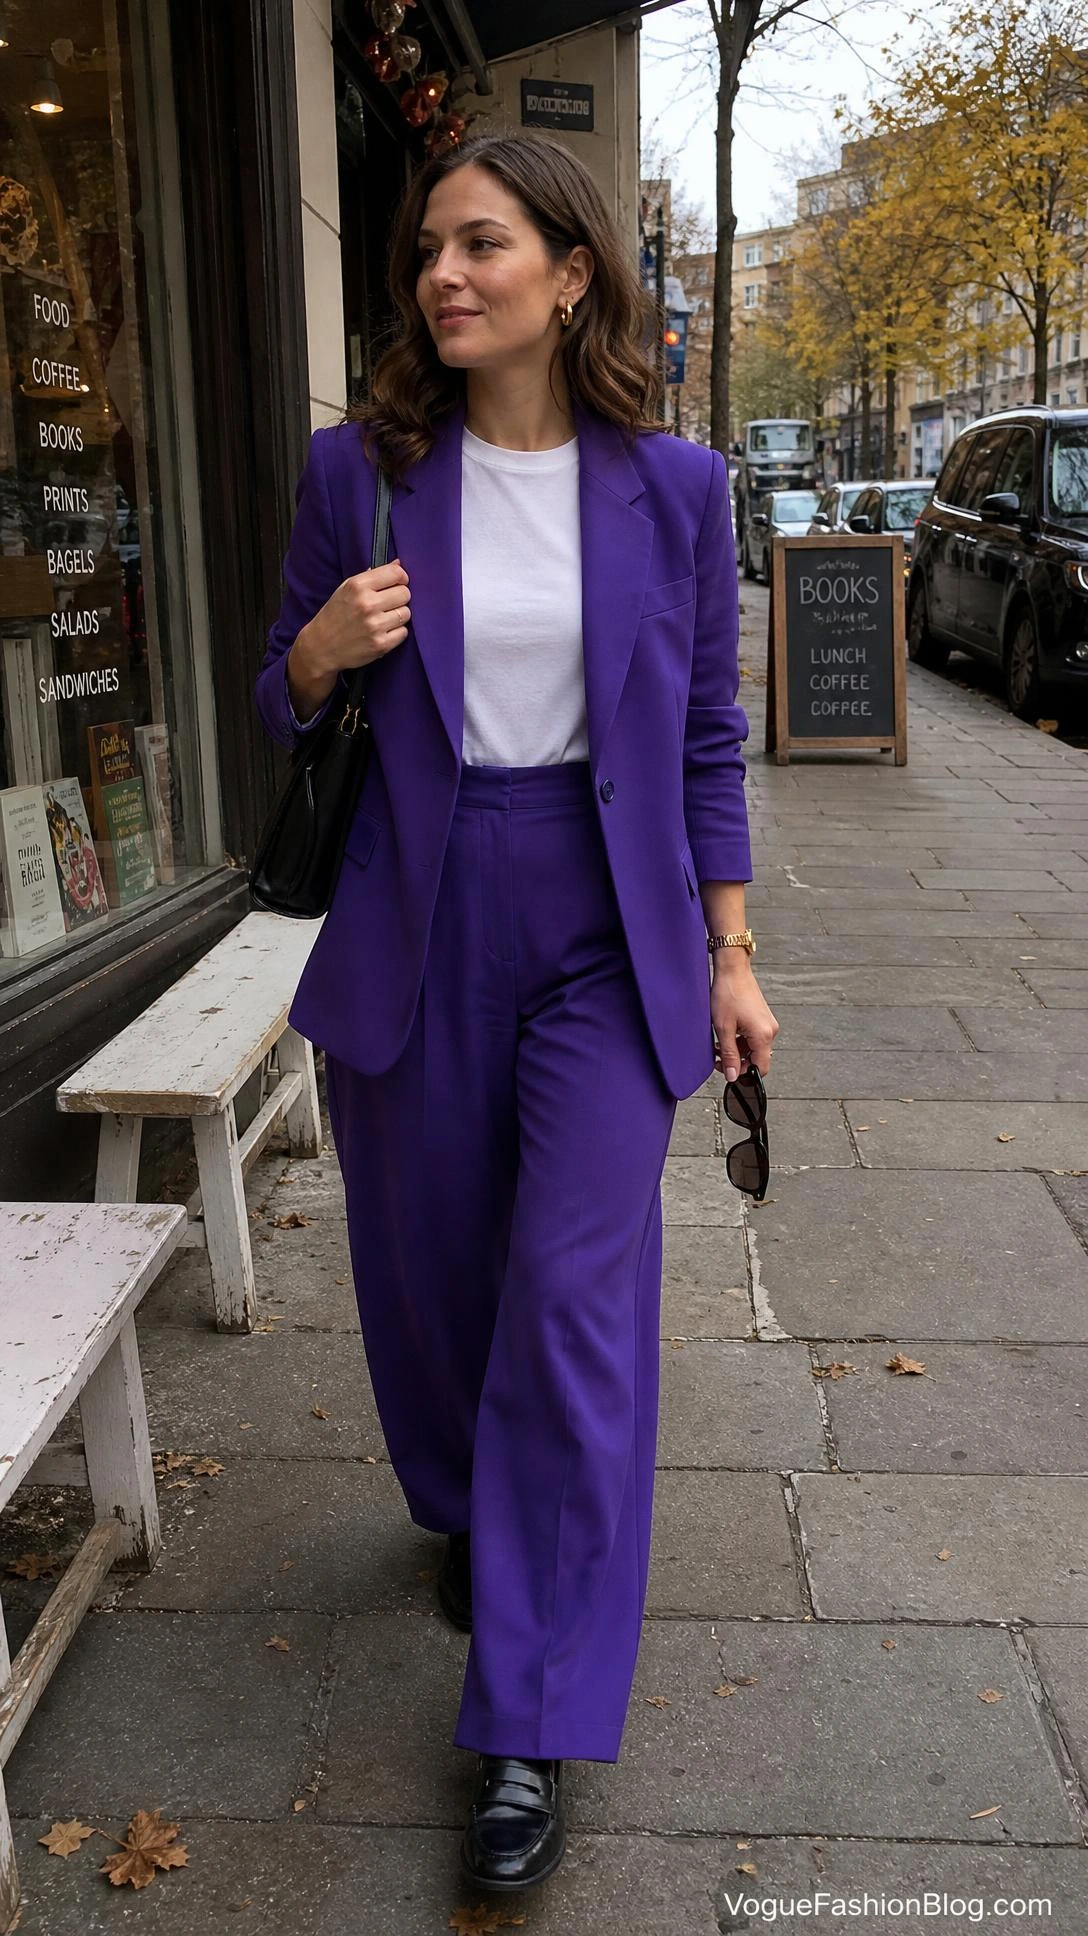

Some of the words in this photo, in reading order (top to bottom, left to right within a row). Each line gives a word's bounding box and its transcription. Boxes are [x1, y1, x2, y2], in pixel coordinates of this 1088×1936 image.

[33, 294, 70, 328] FOOD
[32, 358, 81, 391] COFFEE
[39, 422, 84, 452] BOOKS
[43, 486, 89, 513] PRINTS
[47, 549, 95, 575] BAGELS
[800, 576, 879, 604] BOOKS
[51, 611, 99, 637] SALADS
[811, 648, 866, 664] LUNCH
[39, 668, 119, 704] SANDWICHES
[810, 674, 870, 690] COFFEE
